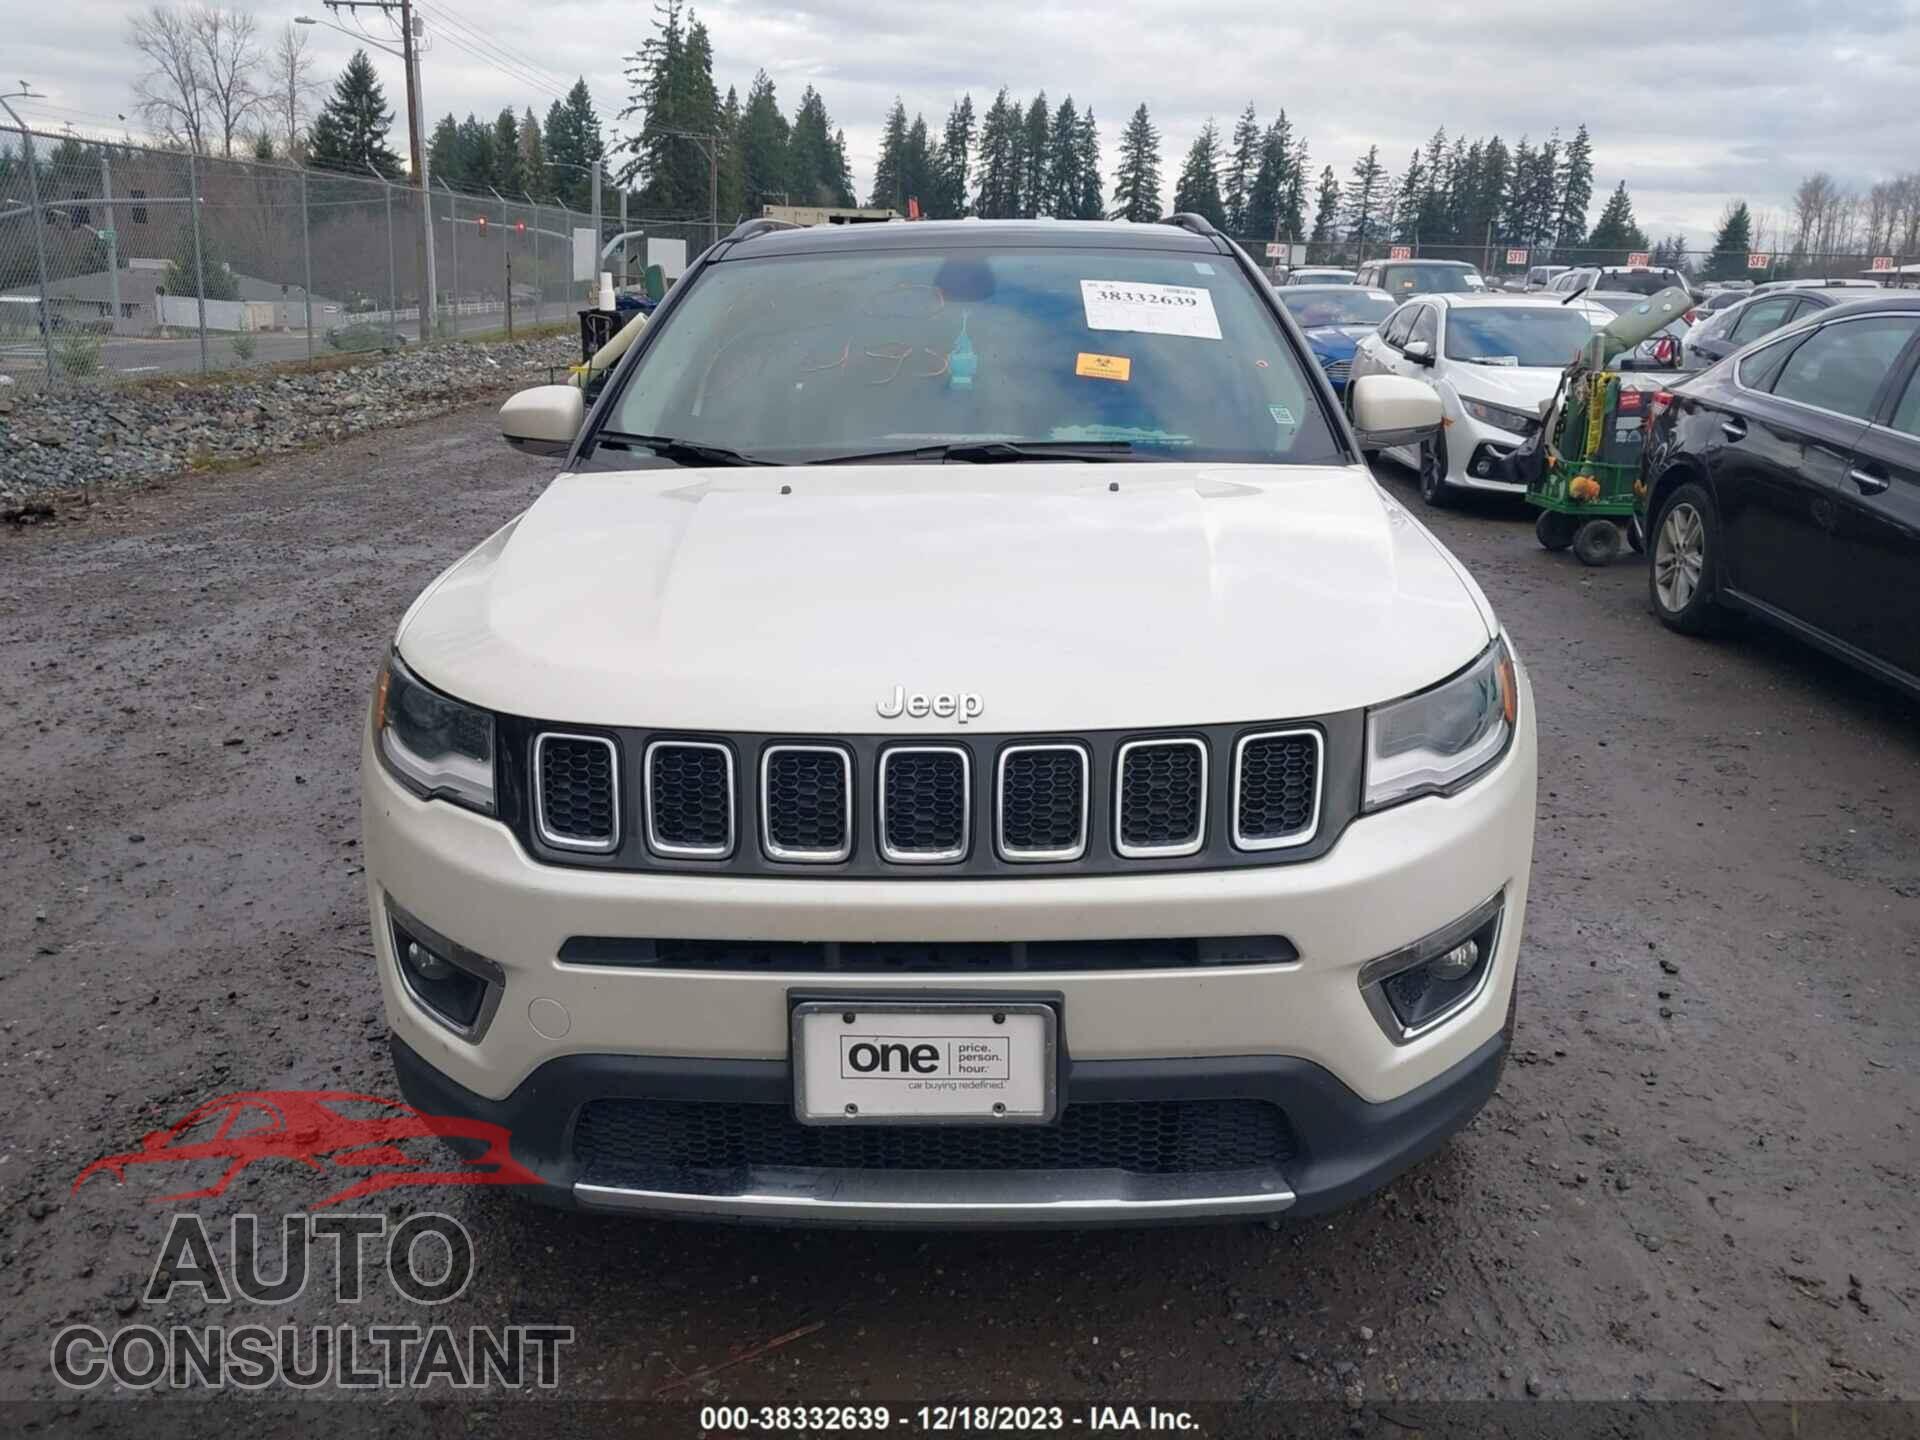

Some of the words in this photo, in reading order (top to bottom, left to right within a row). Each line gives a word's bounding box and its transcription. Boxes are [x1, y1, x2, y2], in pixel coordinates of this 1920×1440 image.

[1392, 248, 1410, 259] SF12
[1508, 251, 1527, 262] SF11
[1629, 255, 1649, 266] SF10
[1749, 256, 1767, 267] SF9
[1874, 259, 1891, 269] SF8
[1096, 290, 1198, 307] 38332639
[876, 684, 984, 725] Jeep
[958, 1042, 992, 1053] price.
[848, 1042, 939, 1073] one
[958, 1054, 1002, 1063] person.
[958, 1063, 988, 1073] hour.
[925, 1080, 957, 1091] buying
